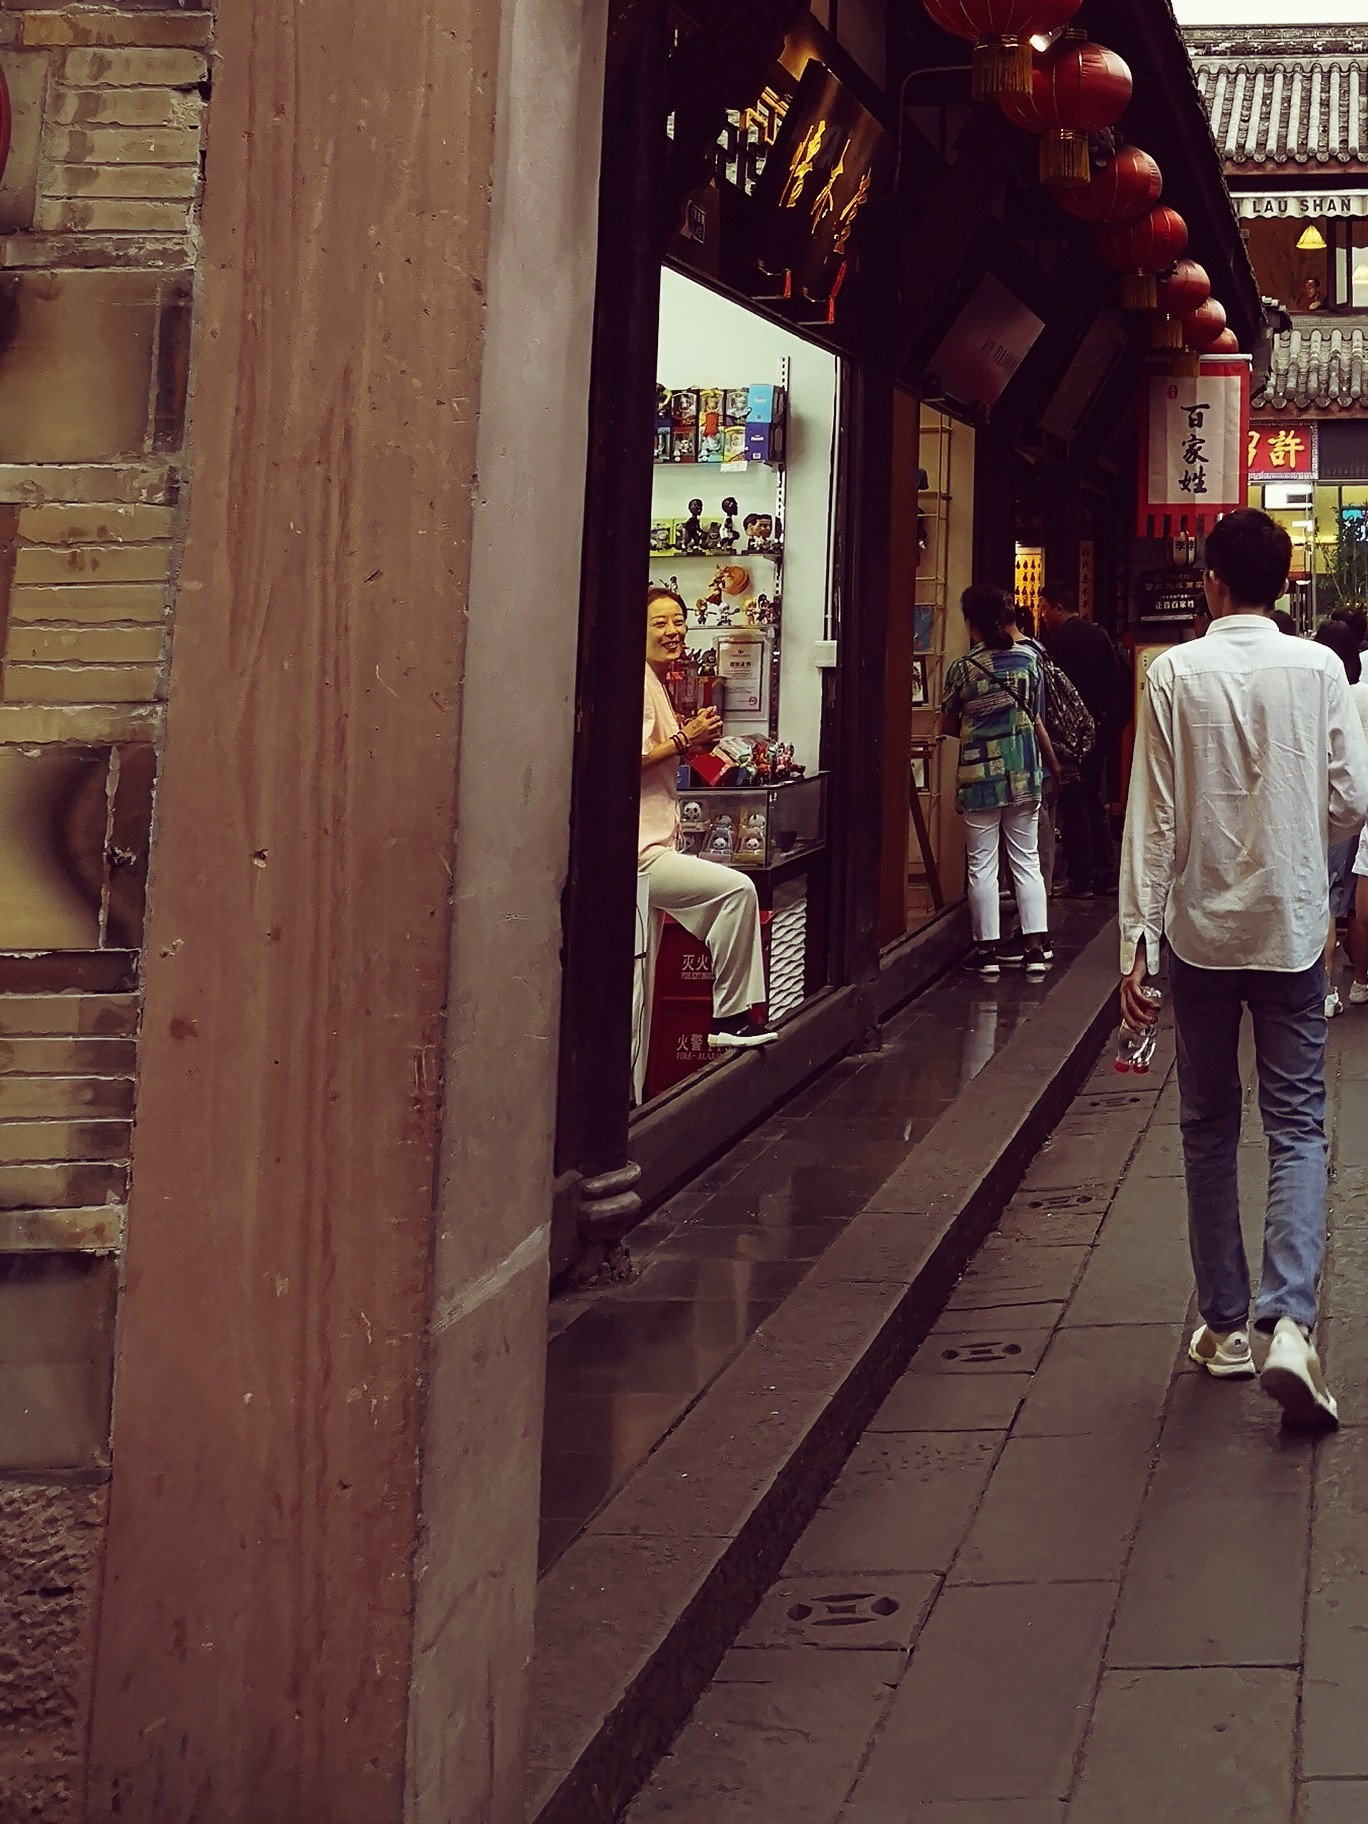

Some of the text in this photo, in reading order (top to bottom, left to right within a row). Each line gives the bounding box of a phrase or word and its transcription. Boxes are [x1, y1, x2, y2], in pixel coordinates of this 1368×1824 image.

[1251, 199, 1289, 214] LAU
[1299, 197, 1353, 213] SHAN
[1177, 402, 1212, 495] 百家姓
[682, 954, 714, 972] 灭火
[676, 1033, 703, 1052] 火警
